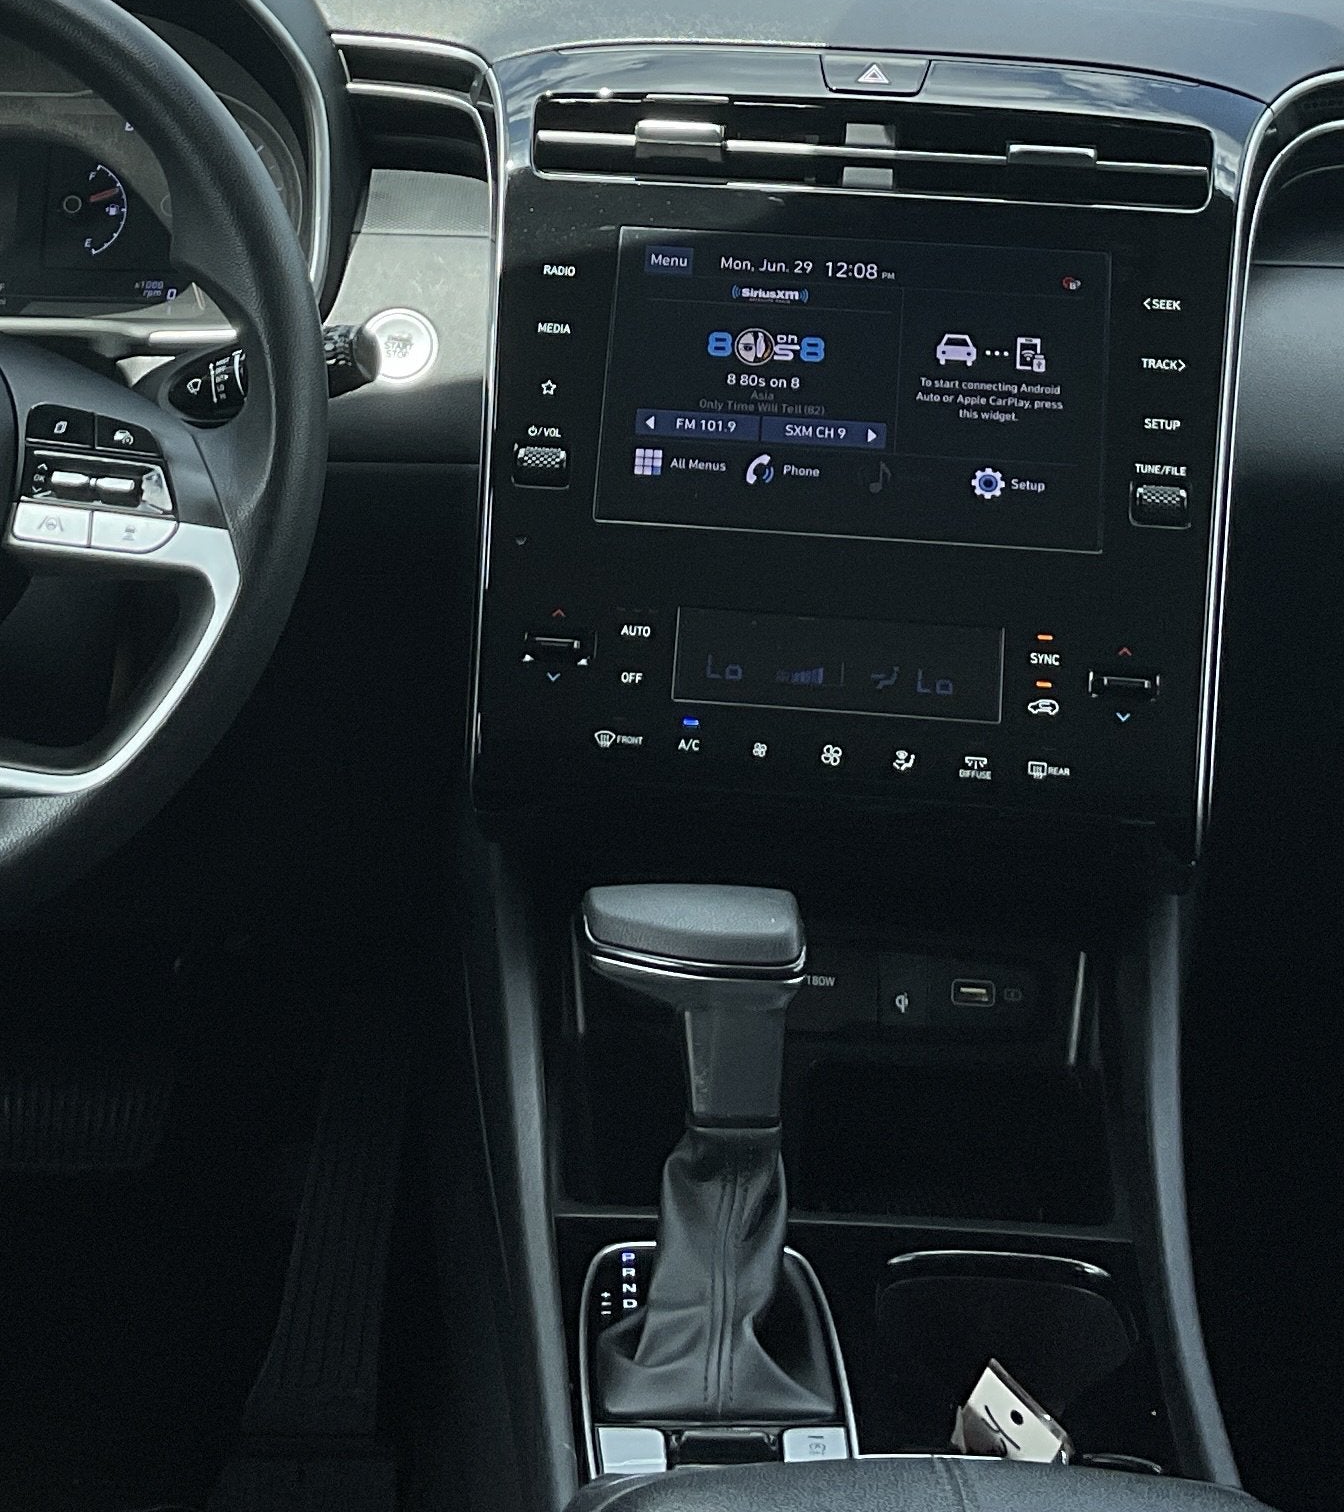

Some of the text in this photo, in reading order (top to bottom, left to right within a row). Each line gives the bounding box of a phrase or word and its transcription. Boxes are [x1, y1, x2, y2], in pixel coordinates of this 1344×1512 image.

[88, 171, 97, 181] F
[84, 238, 92, 249] E
[650, 254, 688, 268] Menu
[543, 264, 576, 277] RADIO
[759, 259, 790, 273] Jun.
[794, 260, 813, 274] 29
[825, 261, 878, 279] 12:08
[881, 272, 896, 280] PM
[143, 289, 162, 298] rpm
[166, 289, 177, 300] 0
[1151, 299, 1182, 311] SEEK
[537, 322, 571, 335] MEDIA
[384, 341, 415, 350] START
[386, 349, 410, 359] STOP
[1141, 357, 1178, 371] TRACK
[727, 373, 800, 388] 8 80s on 8
[920, 377, 1061, 395] To start connecting Android
[750, 390, 775, 401] Asia
[915, 391, 941, 403] Auto
[942, 394, 954, 404] or
[956, 394, 987, 407] Apple
[1034, 400, 1064, 411] press
[699, 399, 826, 416] Only Time Will Tell (82)
[958, 408, 1019, 423] this widget.
[676, 418, 737, 433] FM 101.9
[1144, 418, 1181, 430] SETUP
[785, 424, 847, 439] SXM CH 9
[670, 457, 727, 472] All Menus
[783, 465, 820, 477] Phone
[1134, 463, 1188, 476] TUNE/FILE
[33, 474, 46, 483] OK
[1010, 478, 1046, 493] Setup
[621, 625, 651, 638] AUTO
[1030, 652, 1060, 666] SYNC
[706, 654, 743, 681] Lo
[620, 671, 643, 684] OFF
[916, 668, 953, 695] Lo
[616, 734, 643, 745] FRONT
[678, 738, 700, 752] A/C
[958, 768, 992, 780] DIFFUSE
[1047, 766, 1070, 776] REAR
[621, 1252, 636, 1262] P
[622, 1268, 636, 1277] R
[622, 1283, 637, 1293] N
[622, 1298, 638, 1309] D
